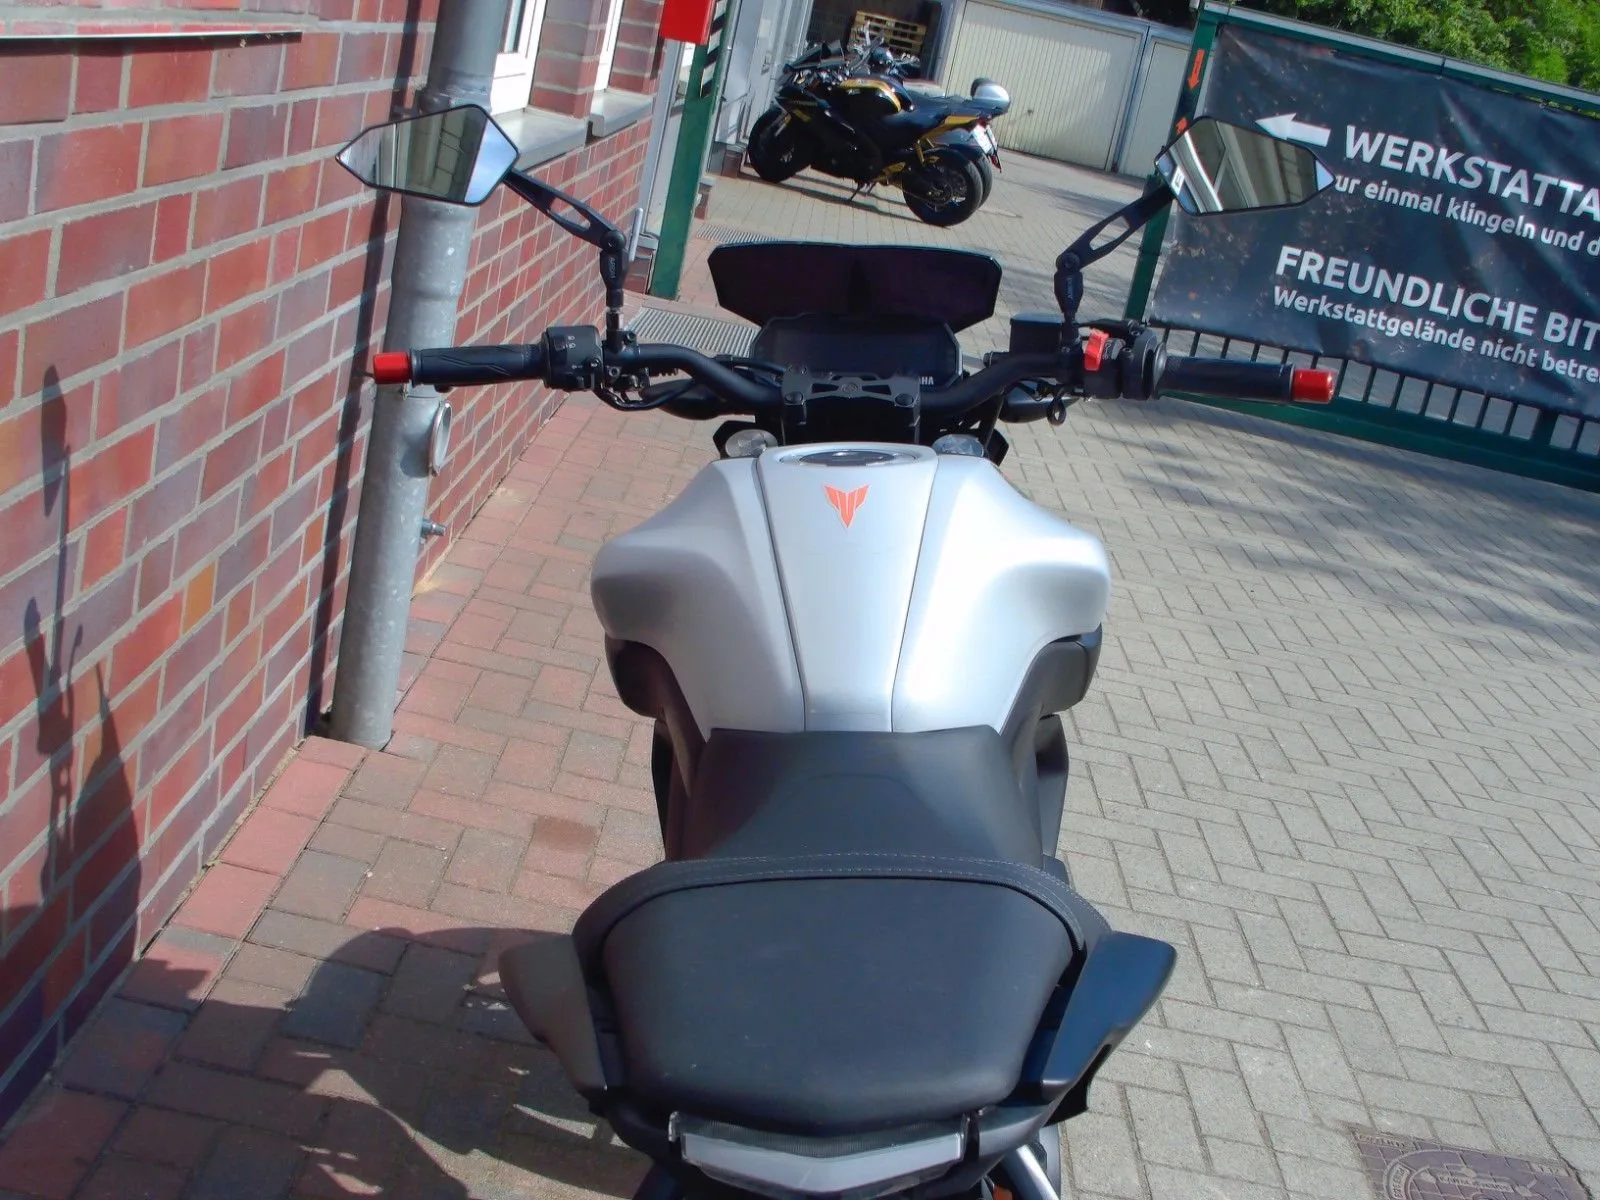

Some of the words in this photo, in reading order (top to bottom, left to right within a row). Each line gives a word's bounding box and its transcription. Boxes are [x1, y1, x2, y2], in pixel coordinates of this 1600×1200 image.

[1335, 174, 1360, 194] ur
[1364, 180, 1443, 215] einmal
[1446, 197, 1536, 240] klingeln
[1541, 227, 1585, 251] und
[1346, 125, 1600, 222] WERKSTATTA
[1274, 286, 1474, 352] Werkstattgelände
[1480, 339, 1538, 368] nicht
[1541, 350, 1600, 383] betre
[1276, 246, 1538, 336] FREUNDLICHE
[1543, 311, 1600, 351] BIT
